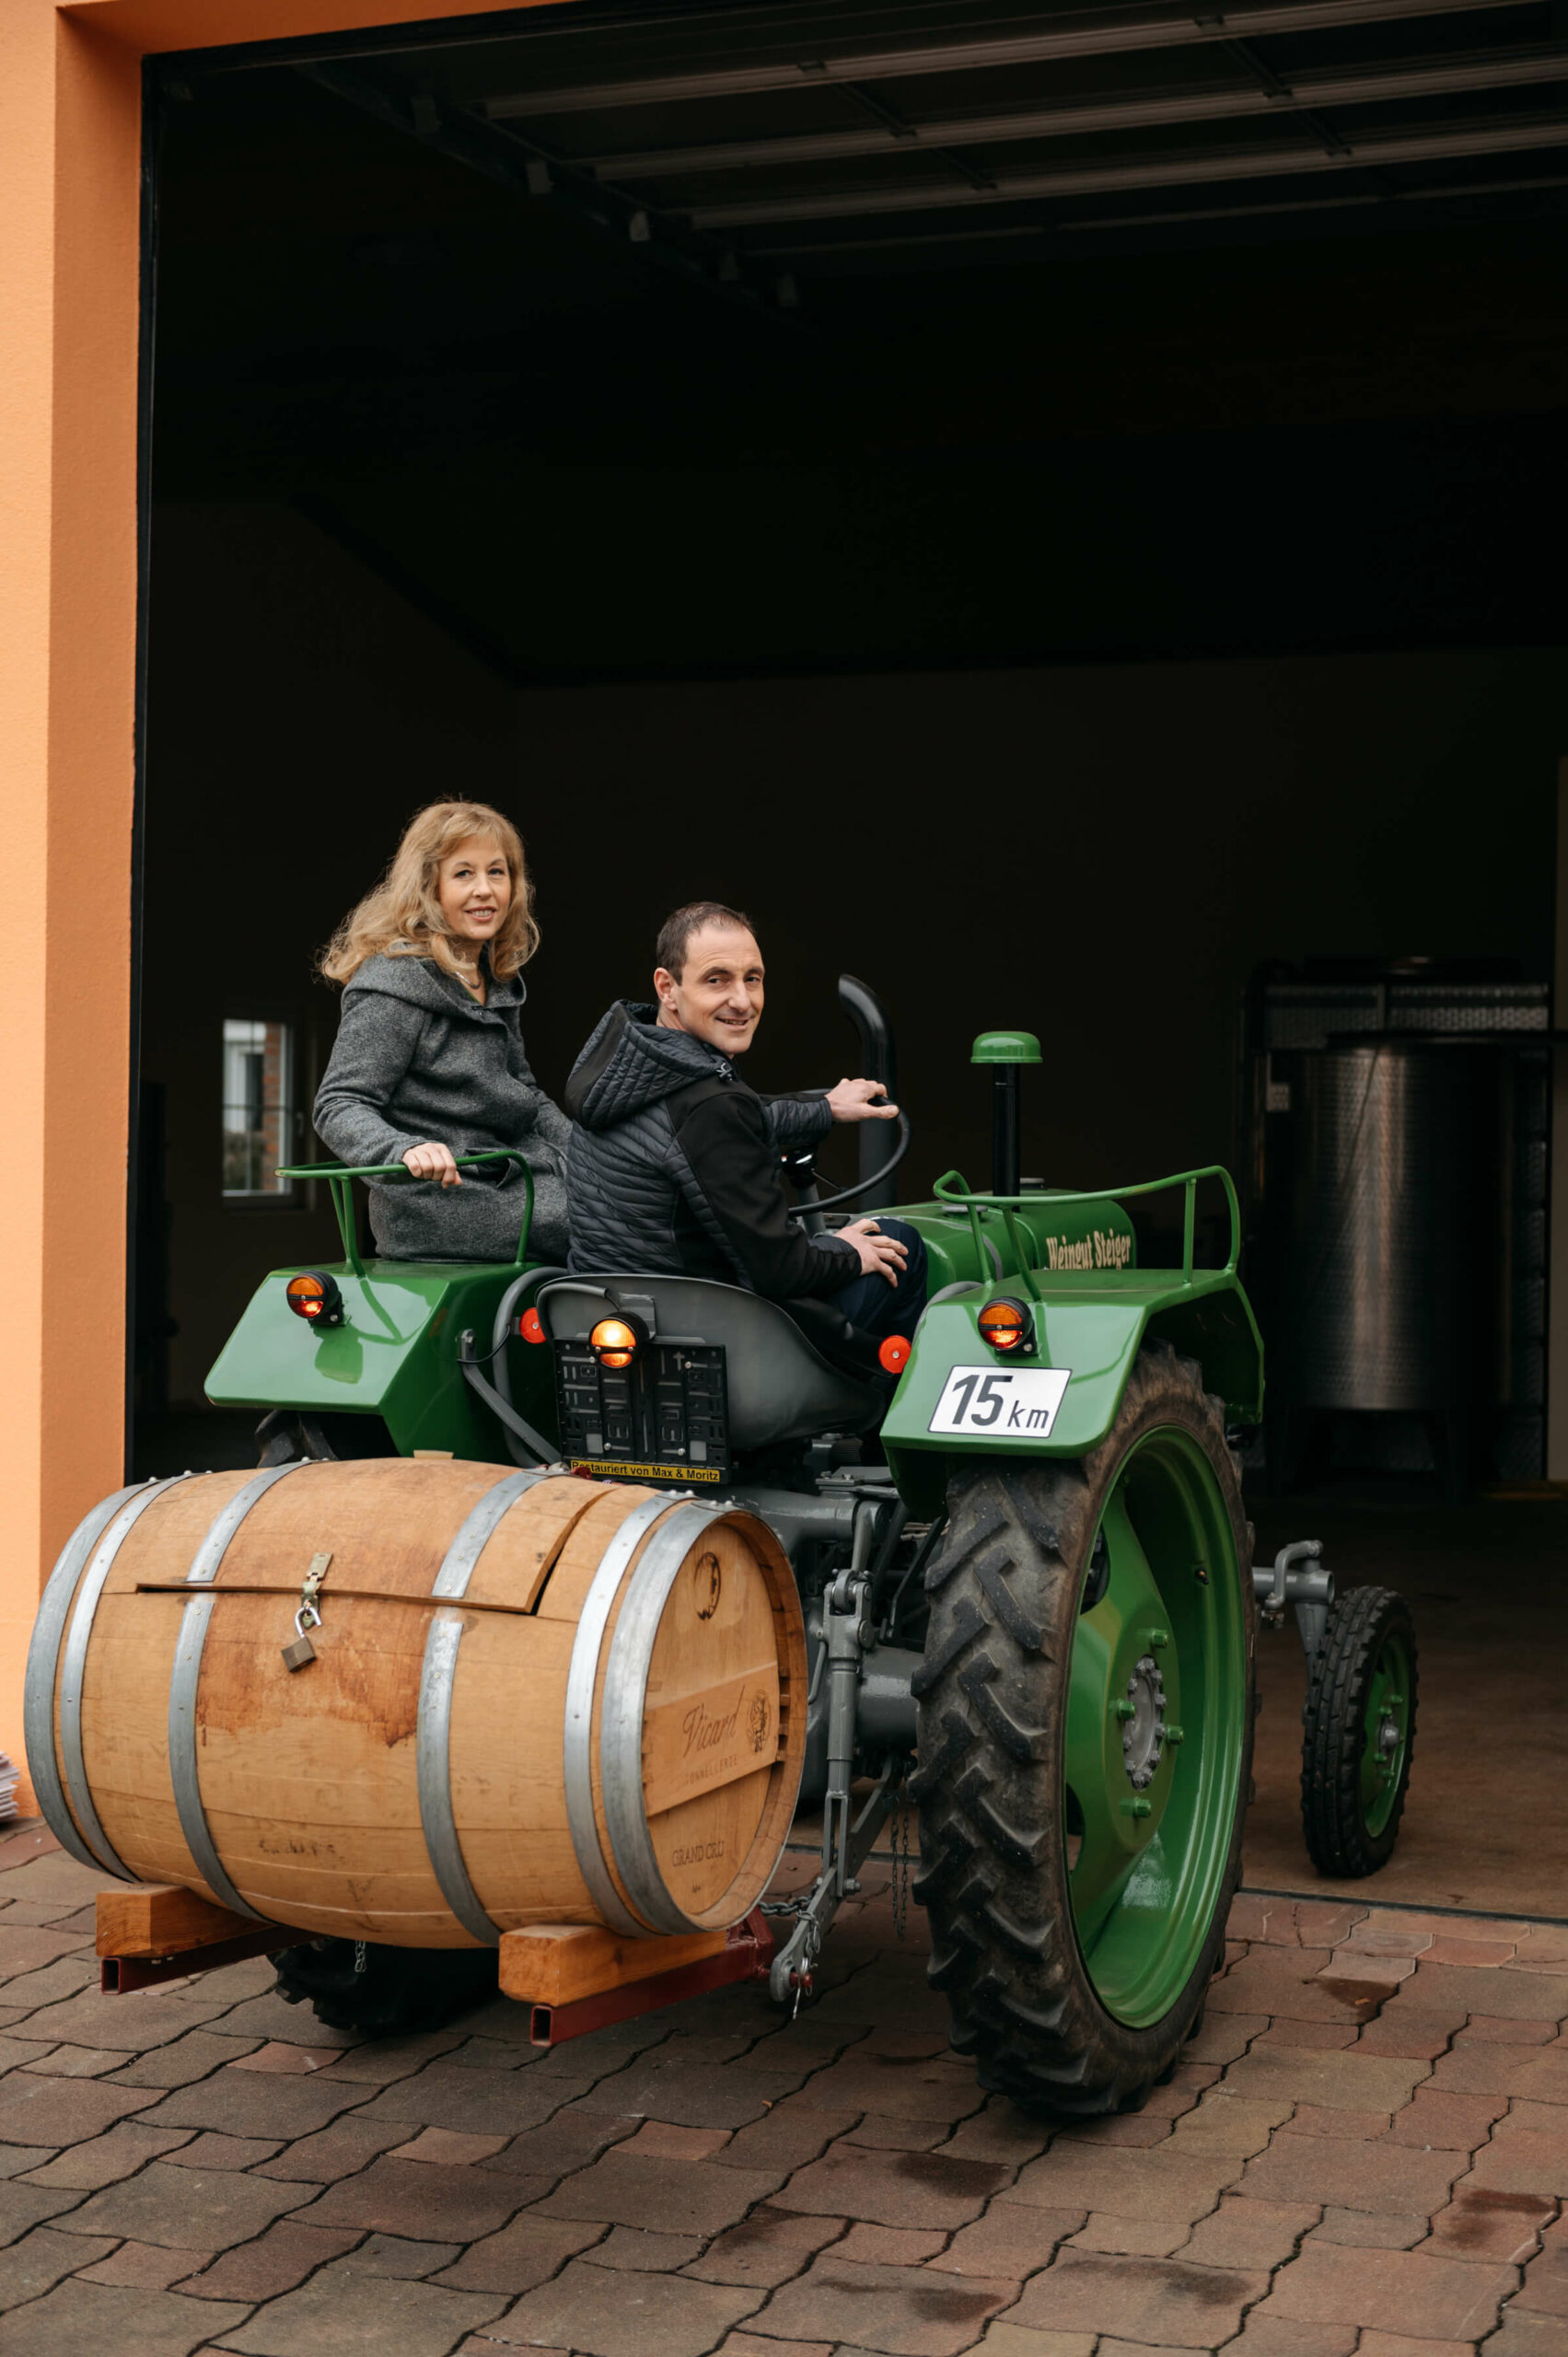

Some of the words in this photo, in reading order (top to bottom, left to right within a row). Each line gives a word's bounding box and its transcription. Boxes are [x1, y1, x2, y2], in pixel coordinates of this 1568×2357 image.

[1046, 1235, 1093, 1270] Weingut
[1094, 1227, 1131, 1270] Steiger
[952, 1374, 1013, 1426] 15
[1007, 1399, 1050, 1429] km
[631, 1468, 649, 1476] von
[652, 1467, 672, 1477] Max
[676, 1469, 684, 1478] &
[687, 1469, 719, 1480] Moritz
[683, 1685, 745, 1759] Vicard
[671, 1845, 703, 1867] GRAND
[706, 1840, 725, 1860] CRU
